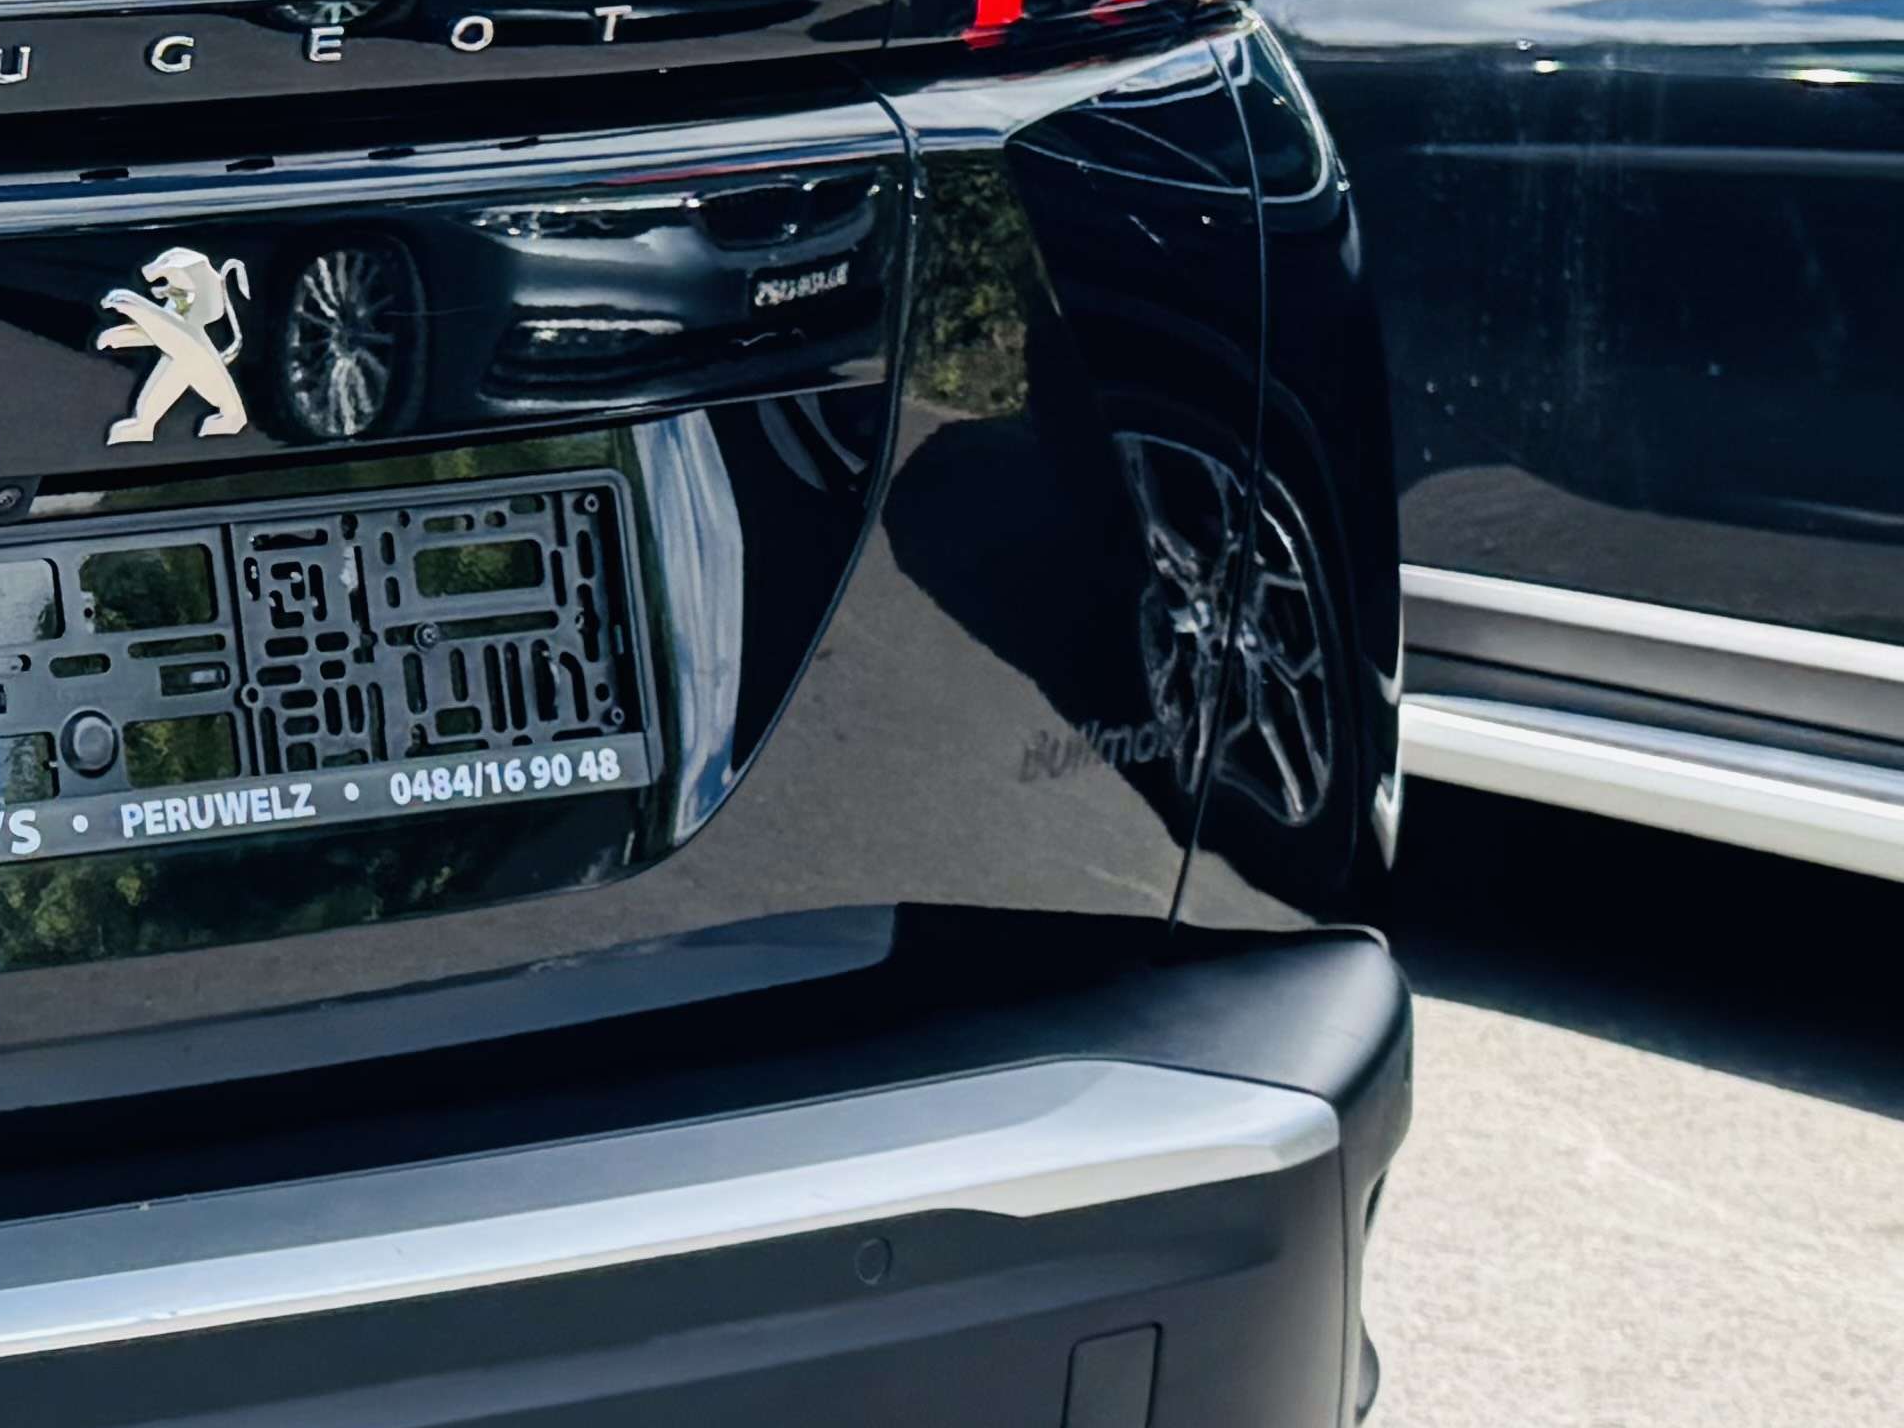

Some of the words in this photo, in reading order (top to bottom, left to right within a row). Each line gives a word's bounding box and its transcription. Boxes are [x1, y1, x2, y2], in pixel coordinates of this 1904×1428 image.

[120, 783, 316, 838] PERUWELZ
[390, 755, 526, 805] 0484/16
[528, 753, 573, 789] 90
[577, 748, 621, 782] 48
